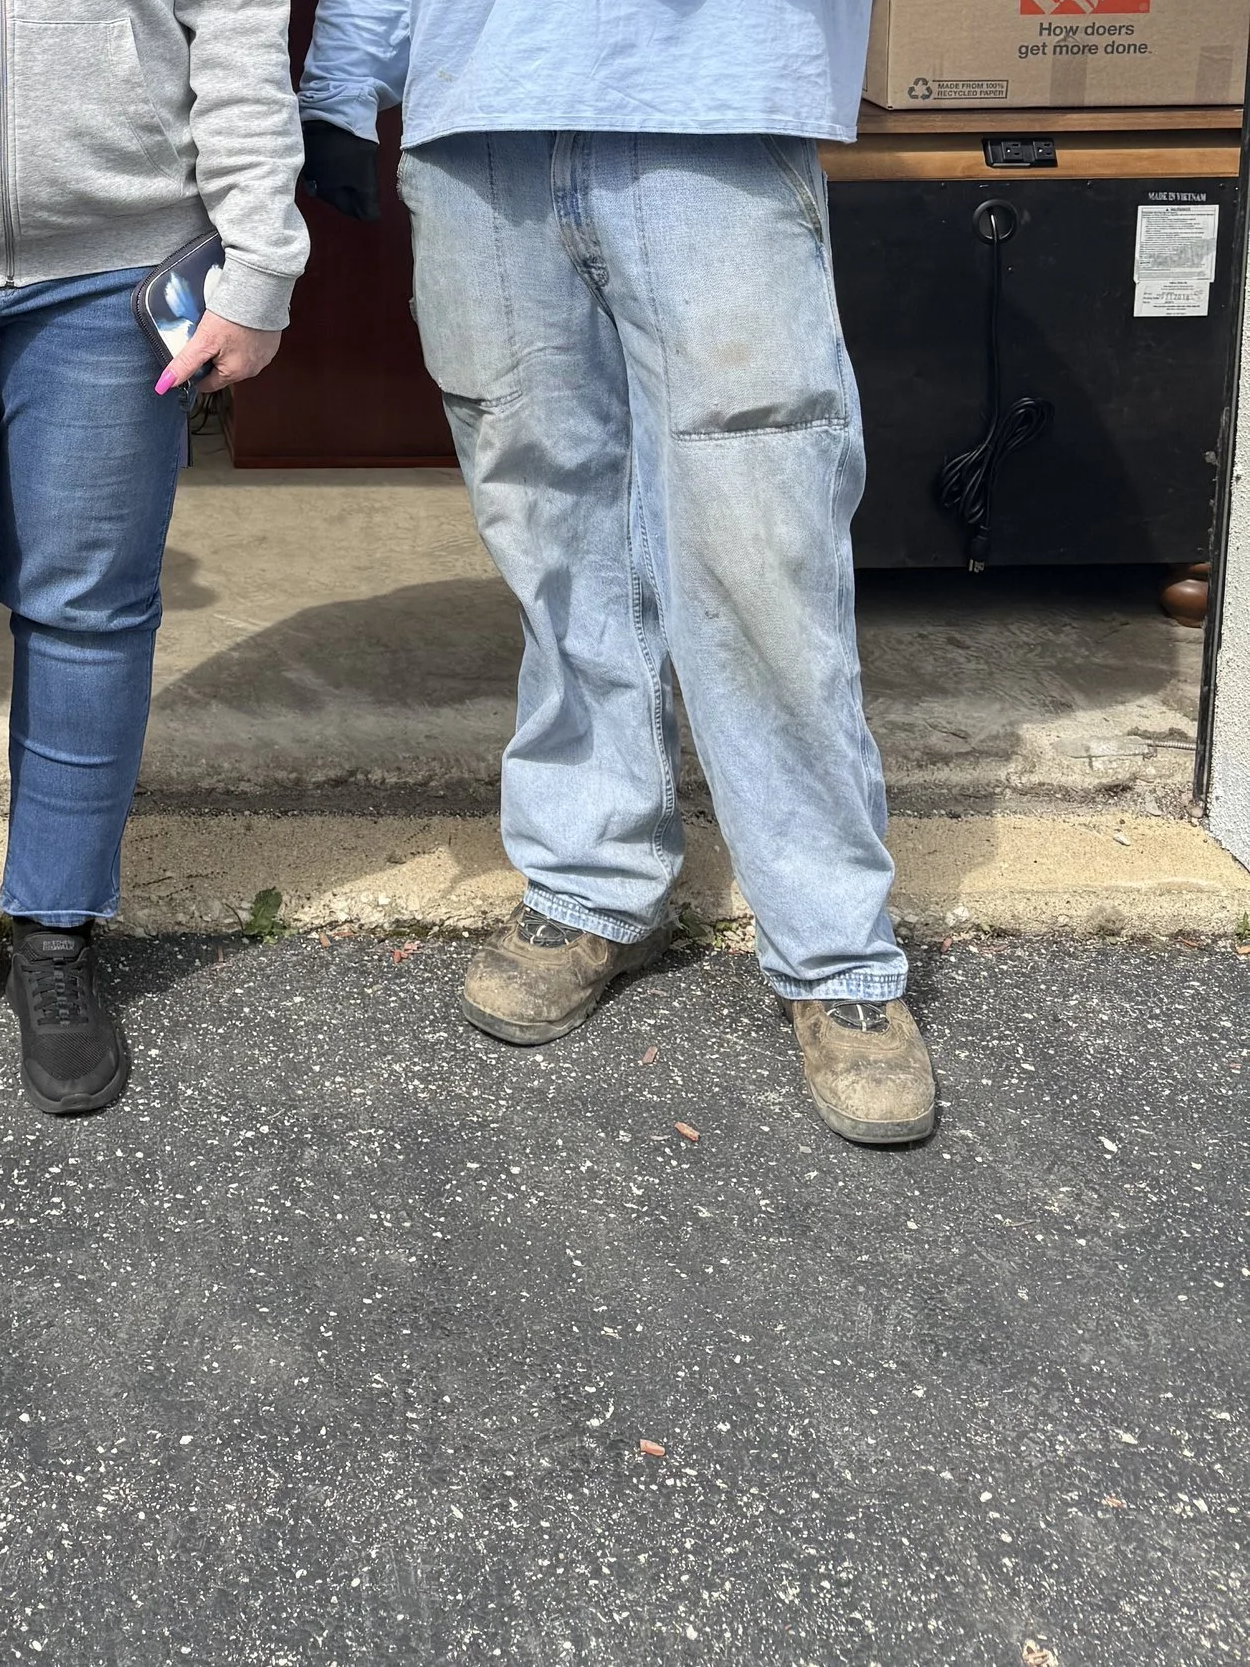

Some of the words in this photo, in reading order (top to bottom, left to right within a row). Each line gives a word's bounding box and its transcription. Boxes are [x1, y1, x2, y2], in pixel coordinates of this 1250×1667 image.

[1038, 22, 1079, 36] How
[1084, 22, 1134, 36] doers
[1018, 42, 1048, 59] get
[1053, 43, 1098, 55] more
[1148, 192, 1168, 201] MADE
[1169, 192, 1176, 201] IN
[1177, 192, 1207, 201] VIETNAM
